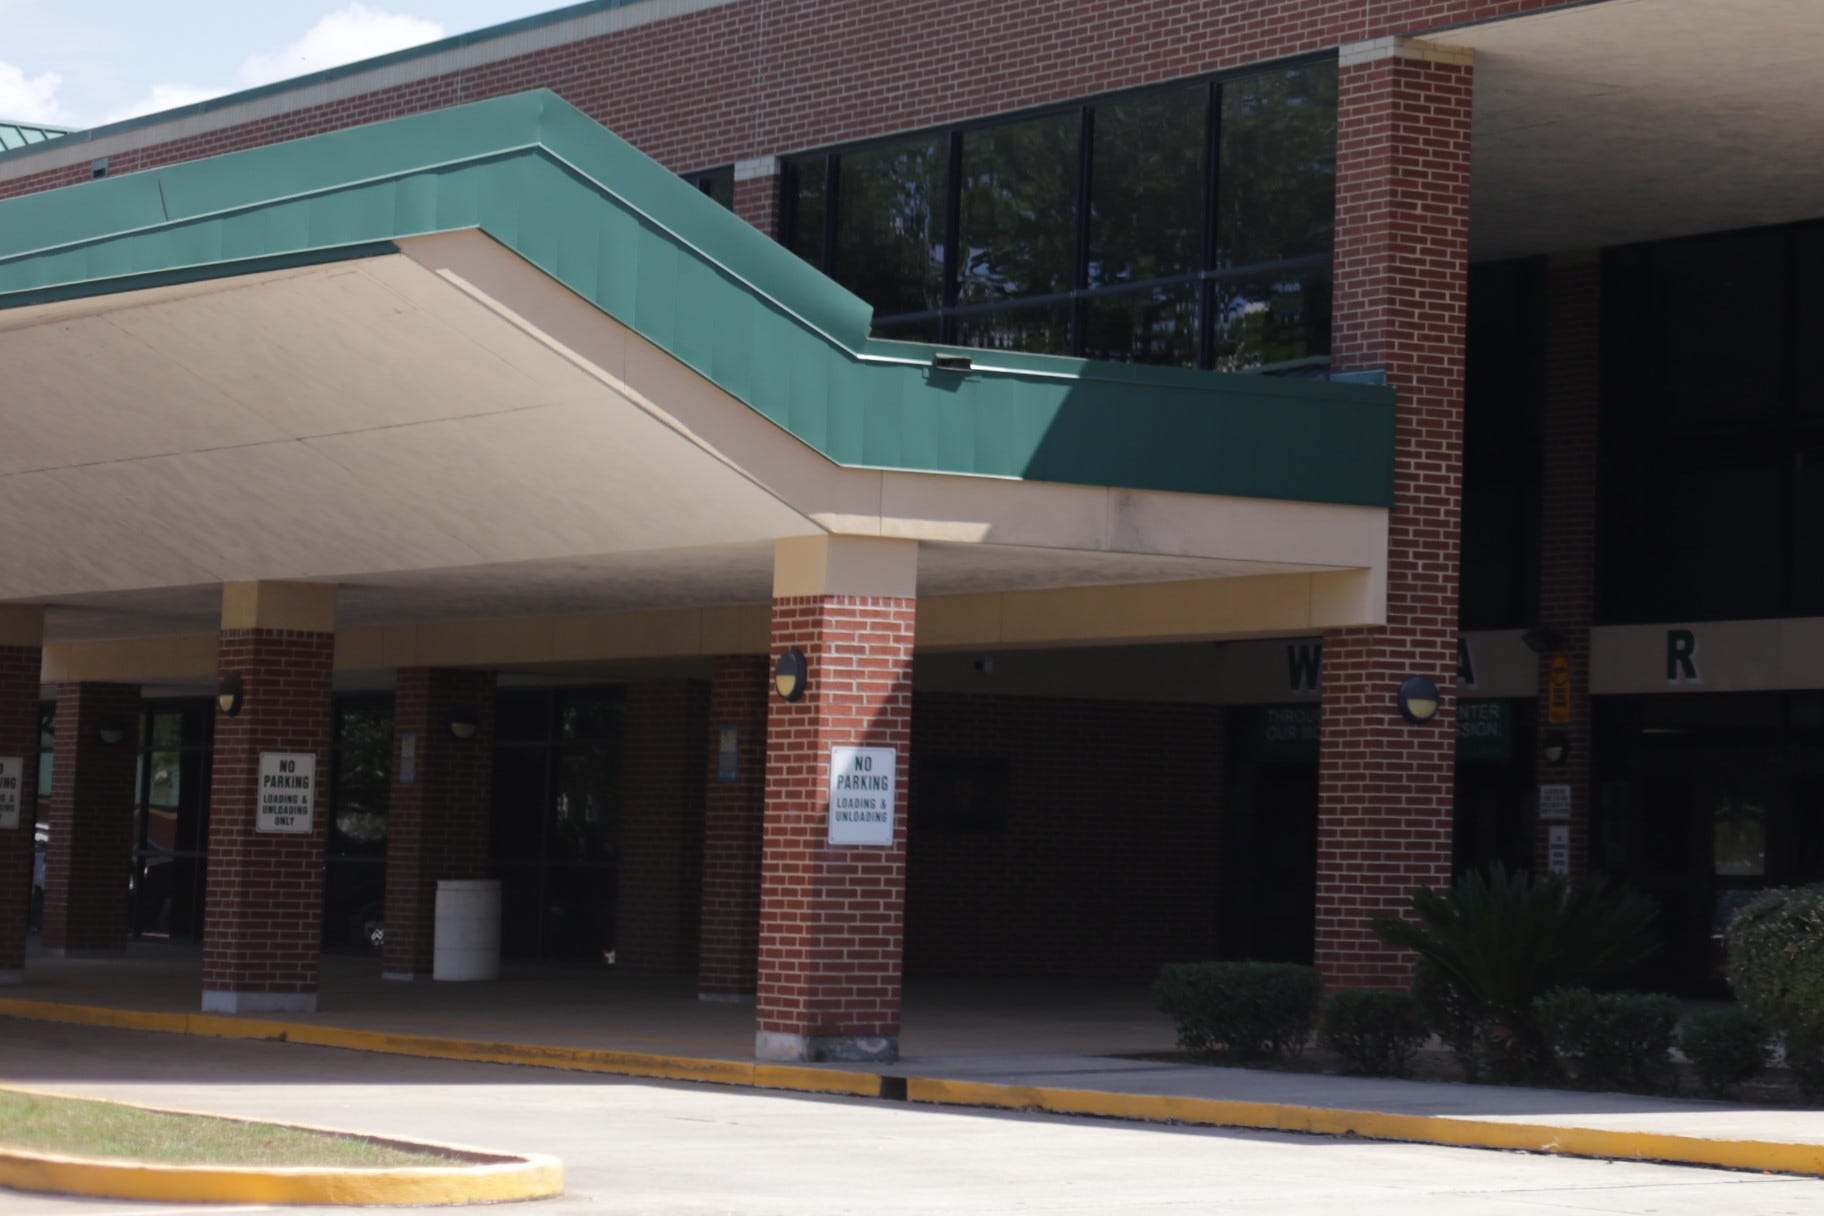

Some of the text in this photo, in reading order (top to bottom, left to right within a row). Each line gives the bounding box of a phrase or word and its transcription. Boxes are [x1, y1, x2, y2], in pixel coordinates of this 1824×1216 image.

[279, 759, 295, 773] NO
[855, 756, 872, 771] NO
[264, 775, 309, 789] PARKING
[837, 775, 889, 791] PARKING
[263, 794, 298, 804] LOADING
[836, 798, 887, 810] LOADING &
[262, 805, 308, 815] UNLOADING
[274, 816, 295, 826] ONLY
[835, 811, 888, 823] UNLOADING
